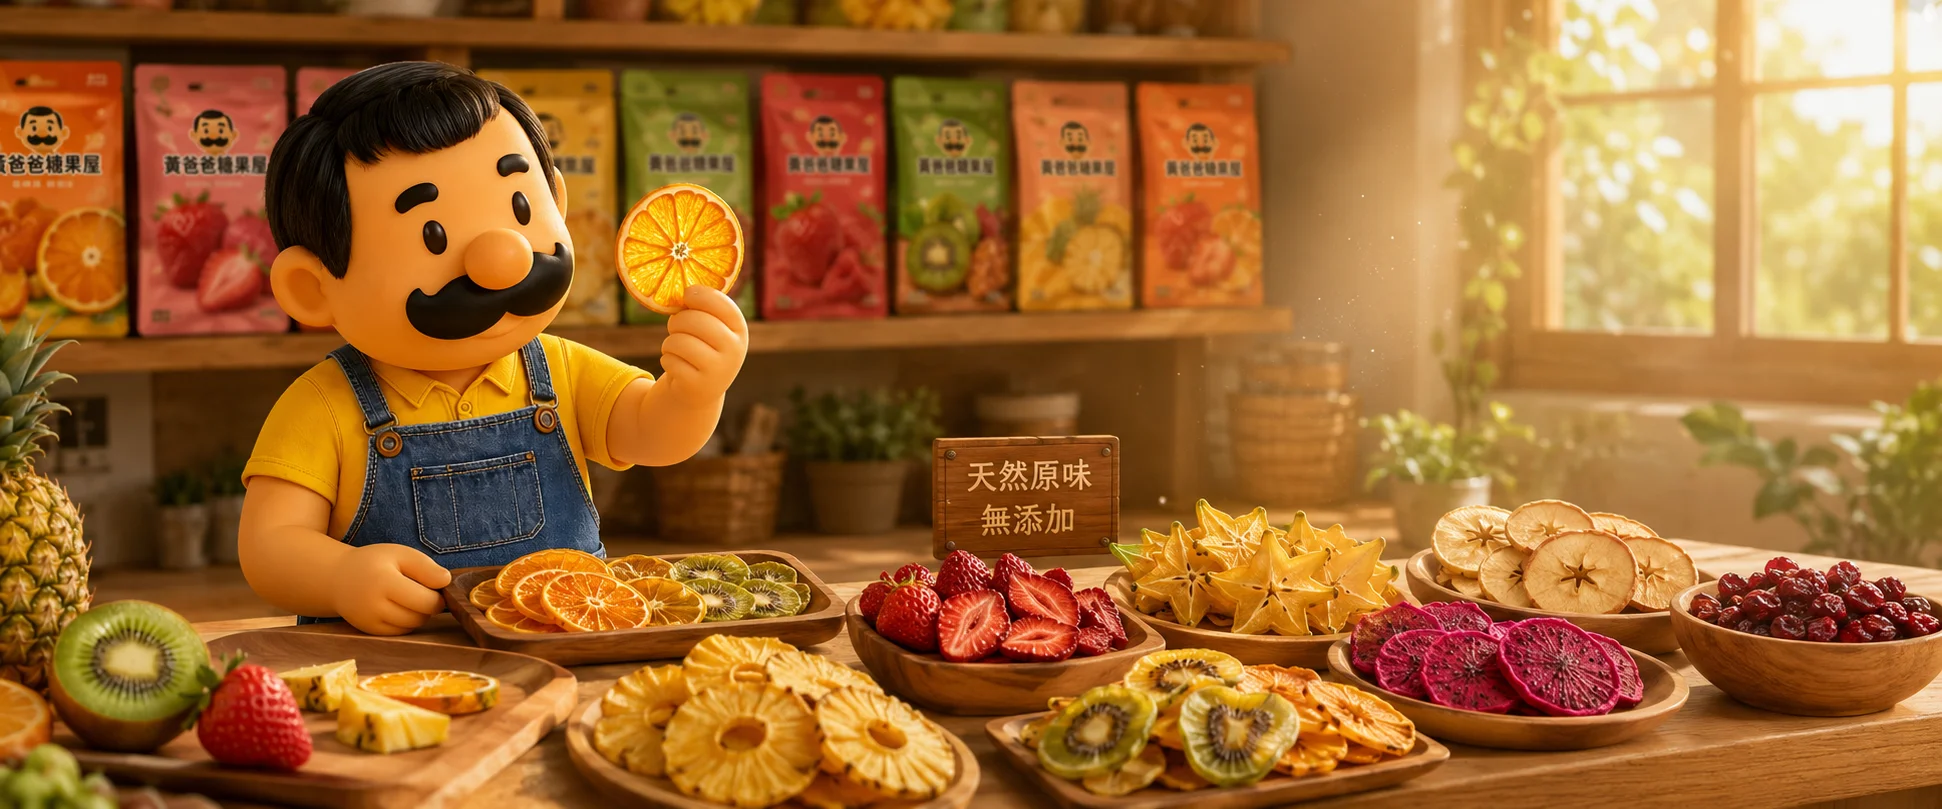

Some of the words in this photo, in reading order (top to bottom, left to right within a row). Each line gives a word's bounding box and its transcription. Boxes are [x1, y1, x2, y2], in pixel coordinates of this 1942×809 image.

[967, 458, 1092, 492] 天然原味
[980, 503, 1075, 537] 無添加
